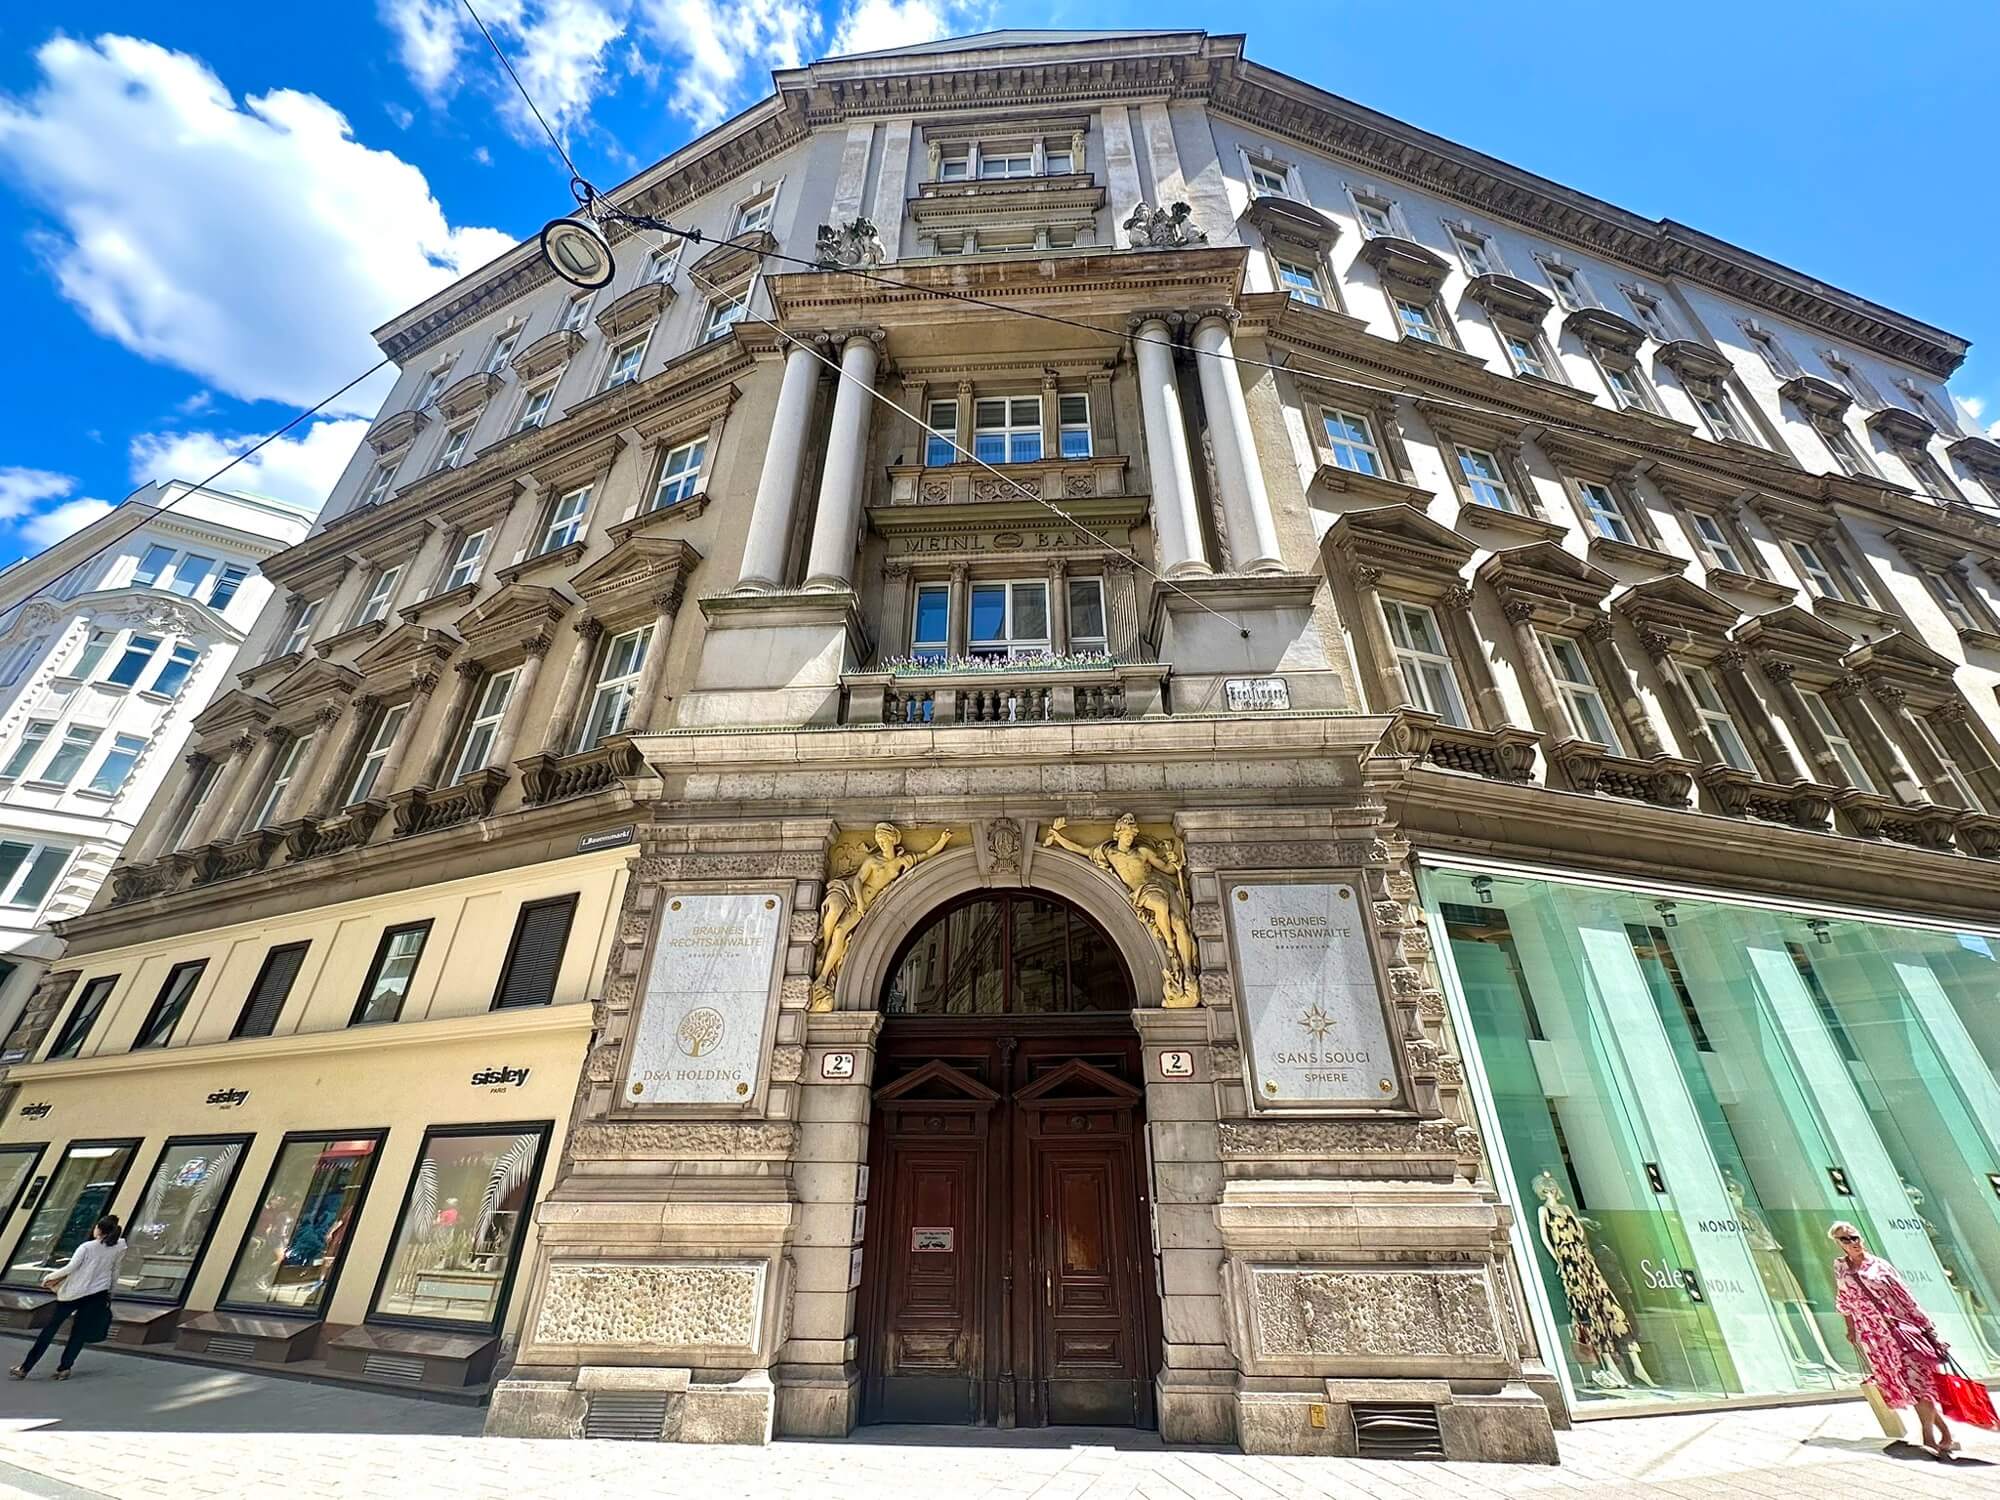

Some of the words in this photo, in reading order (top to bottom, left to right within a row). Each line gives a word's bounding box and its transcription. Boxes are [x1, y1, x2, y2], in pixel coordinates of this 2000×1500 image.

[904, 536, 985, 553] MEINL
[1035, 530, 1109, 548] BANK
[1270, 916, 1327, 926] BRAUNEIS
[1171, 1053, 1182, 1070] 2
[1277, 1052, 1318, 1064] SANS
[1324, 1052, 1370, 1064] SOUCI
[471, 1066, 531, 1087] sisley
[643, 1070, 672, 1081] D&A
[676, 1070, 742, 1081] HOLDING
[1304, 1073, 1349, 1083] SPHERE
[206, 1088, 251, 1106] sisley
[1698, 1219, 1756, 1233] MONDIAL
[1640, 1258, 1685, 1289] Sale
